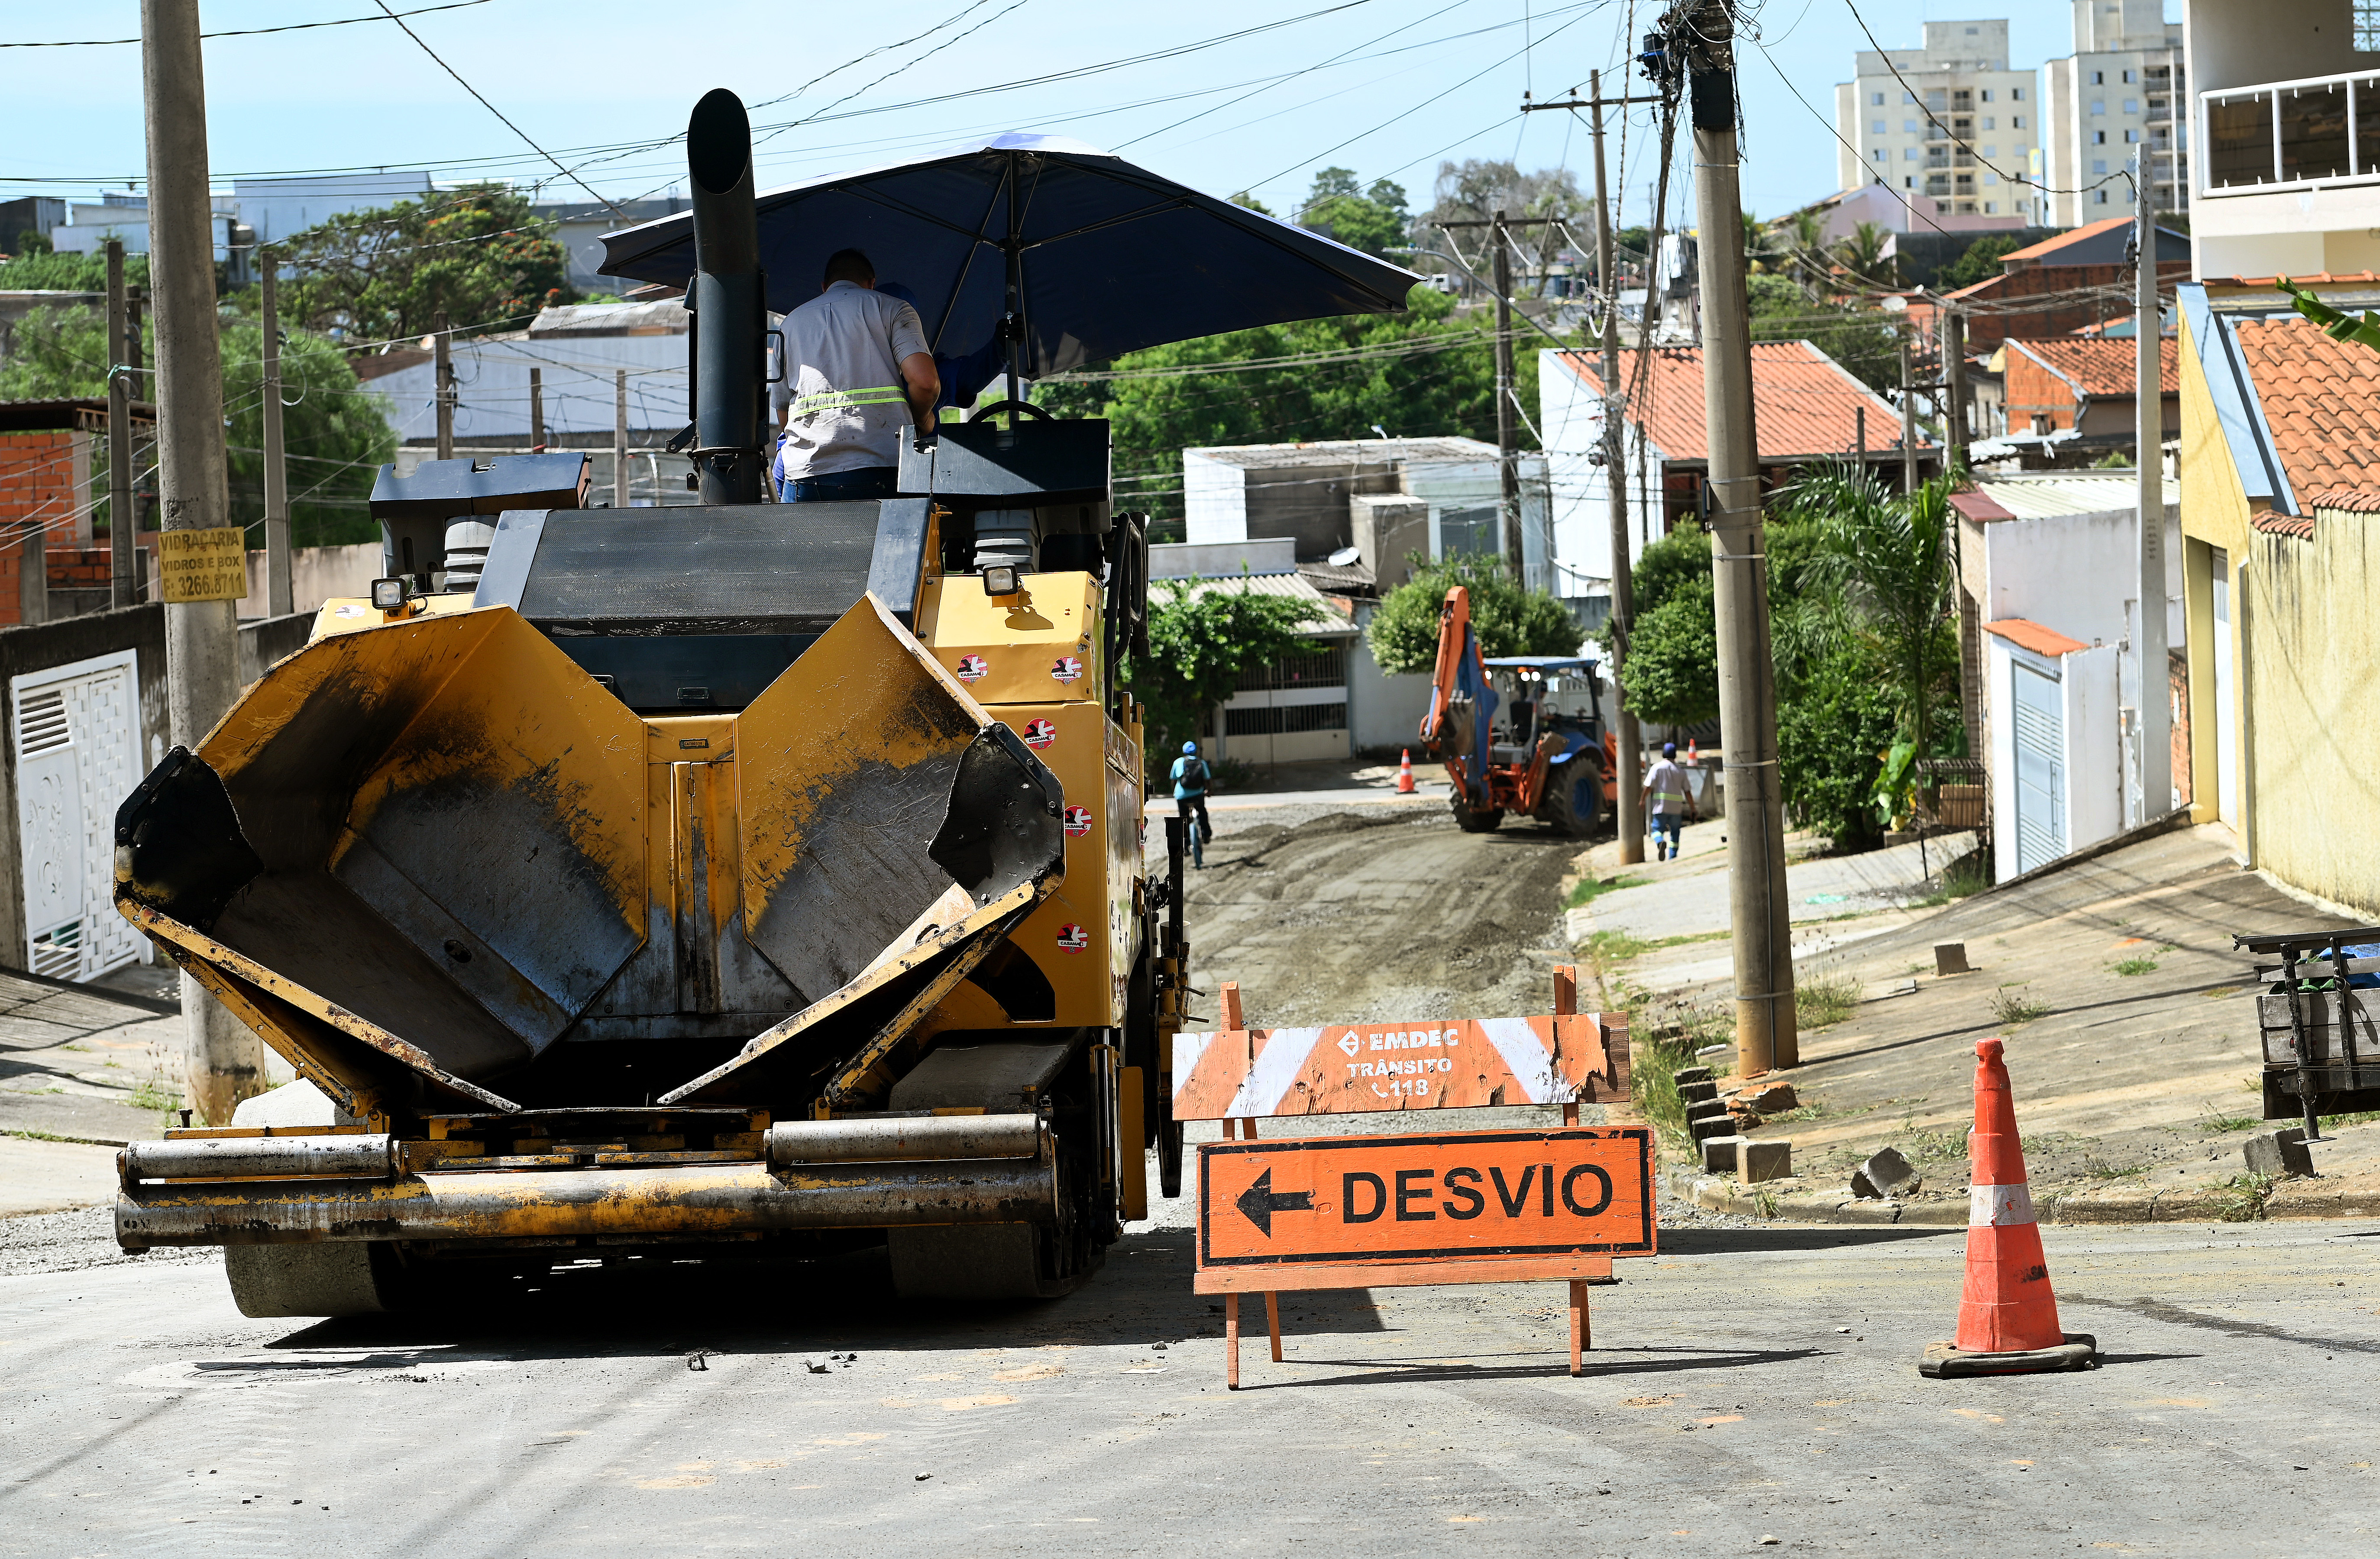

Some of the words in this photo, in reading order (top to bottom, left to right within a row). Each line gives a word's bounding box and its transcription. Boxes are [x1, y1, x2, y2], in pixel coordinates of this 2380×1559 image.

[162, 558, 204, 571] VIDROS
[208, 558, 214, 568] E
[218, 556, 239, 567] BOX
[163, 578, 175, 597] F:
[178, 572, 242, 596] 3266.8711
[1369, 1029, 1459, 1051] EMDEC
[1346, 1059, 1452, 1078] TRÂNSITO
[1390, 1079, 1429, 1097] 118
[1343, 1164, 1613, 1223] DESVIO
